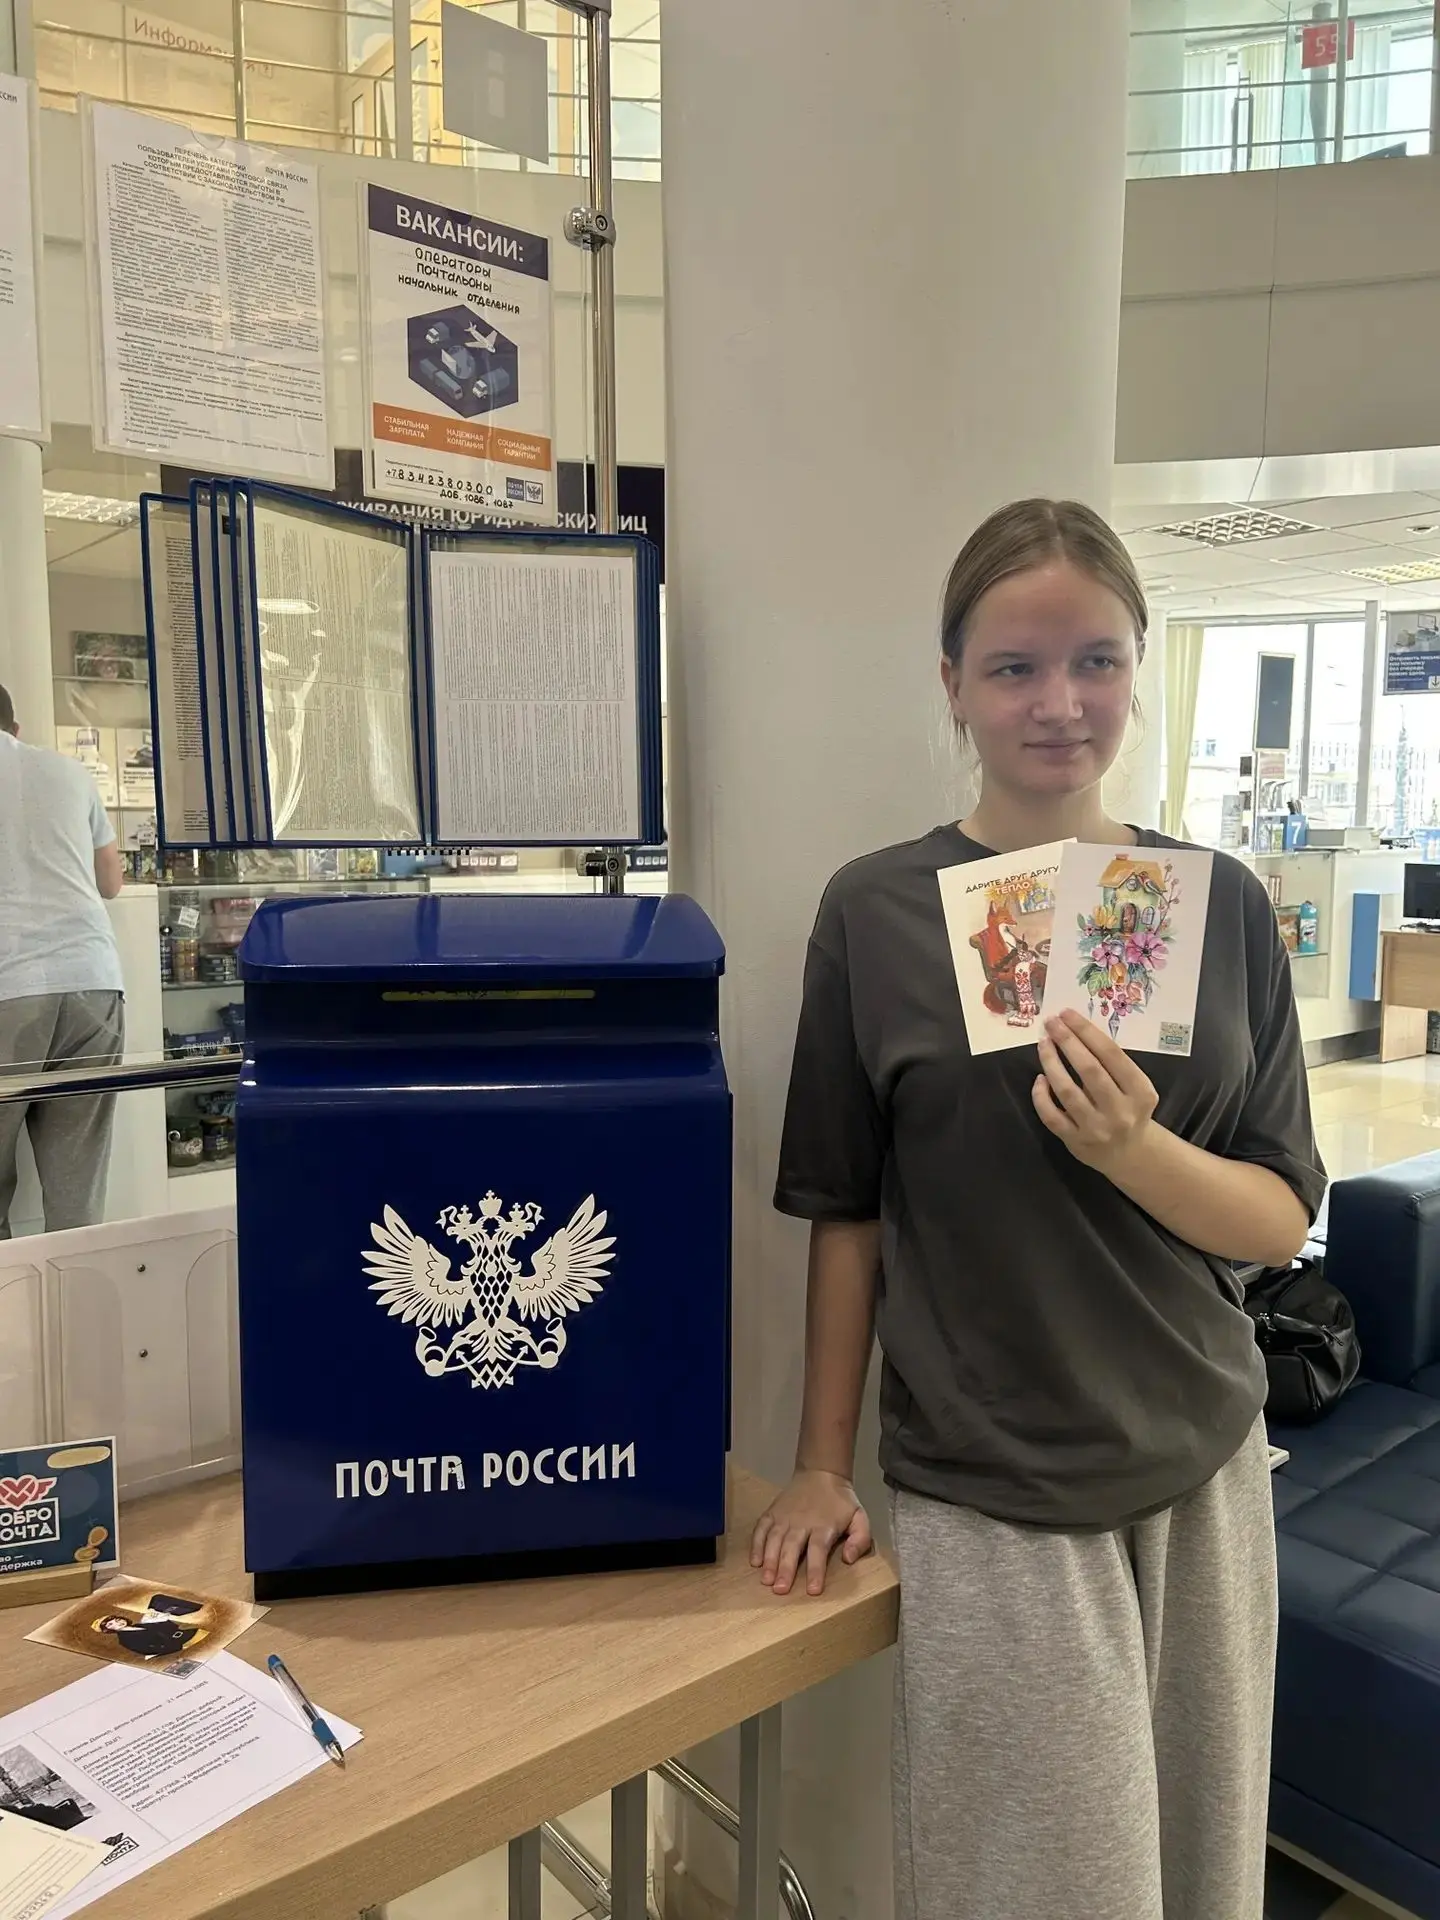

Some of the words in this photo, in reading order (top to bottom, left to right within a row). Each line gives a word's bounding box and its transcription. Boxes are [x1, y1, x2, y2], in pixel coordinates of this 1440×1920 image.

[174, 146, 209, 162] ПЕРЕЧЕНЬ
[210, 155, 247, 172] КАТЕГОРИЙ
[147, 154, 181, 169] КОТОРЫМ
[182, 161, 248, 187] ПРЕДОСТАВЛЯЮТСЯ
[231, 167, 266, 184] ПОЧТОВОЙ
[143, 160, 197, 180] СООТВЕТСТВИИ
[203, 176, 275, 202] ЗАКОНОДАТЕЛЬСТВОМ
[396, 204, 524, 262] ВАКАНСИИ:
[384, 415, 430, 431] СТАБИЛЬНАЯ
[389, 425, 425, 439] ЗАРПЛАТА
[446, 437, 484, 451] КОМПАНИЯ
[497, 438, 541, 453] СОЦИАЛЬНЫЕ
[504, 447, 536, 461] ГАРАНТИИ
[617, 514, 648, 534] ИЦ
[1291, 821, 1302, 845] 7
[965, 878, 1001, 894] ДАРИТЕ
[1004, 872, 1028, 885] ДРУГ
[1030, 865, 1059, 879] ДРУГУ
[336, 1455, 466, 1499] ПОЧТА
[483, 1442, 636, 1488] РОССИИ
[0, 1507, 52, 1526] ОБРО
[0, 1522, 54, 1541] ОЧТА
[0, 1559, 43, 1572] держка
